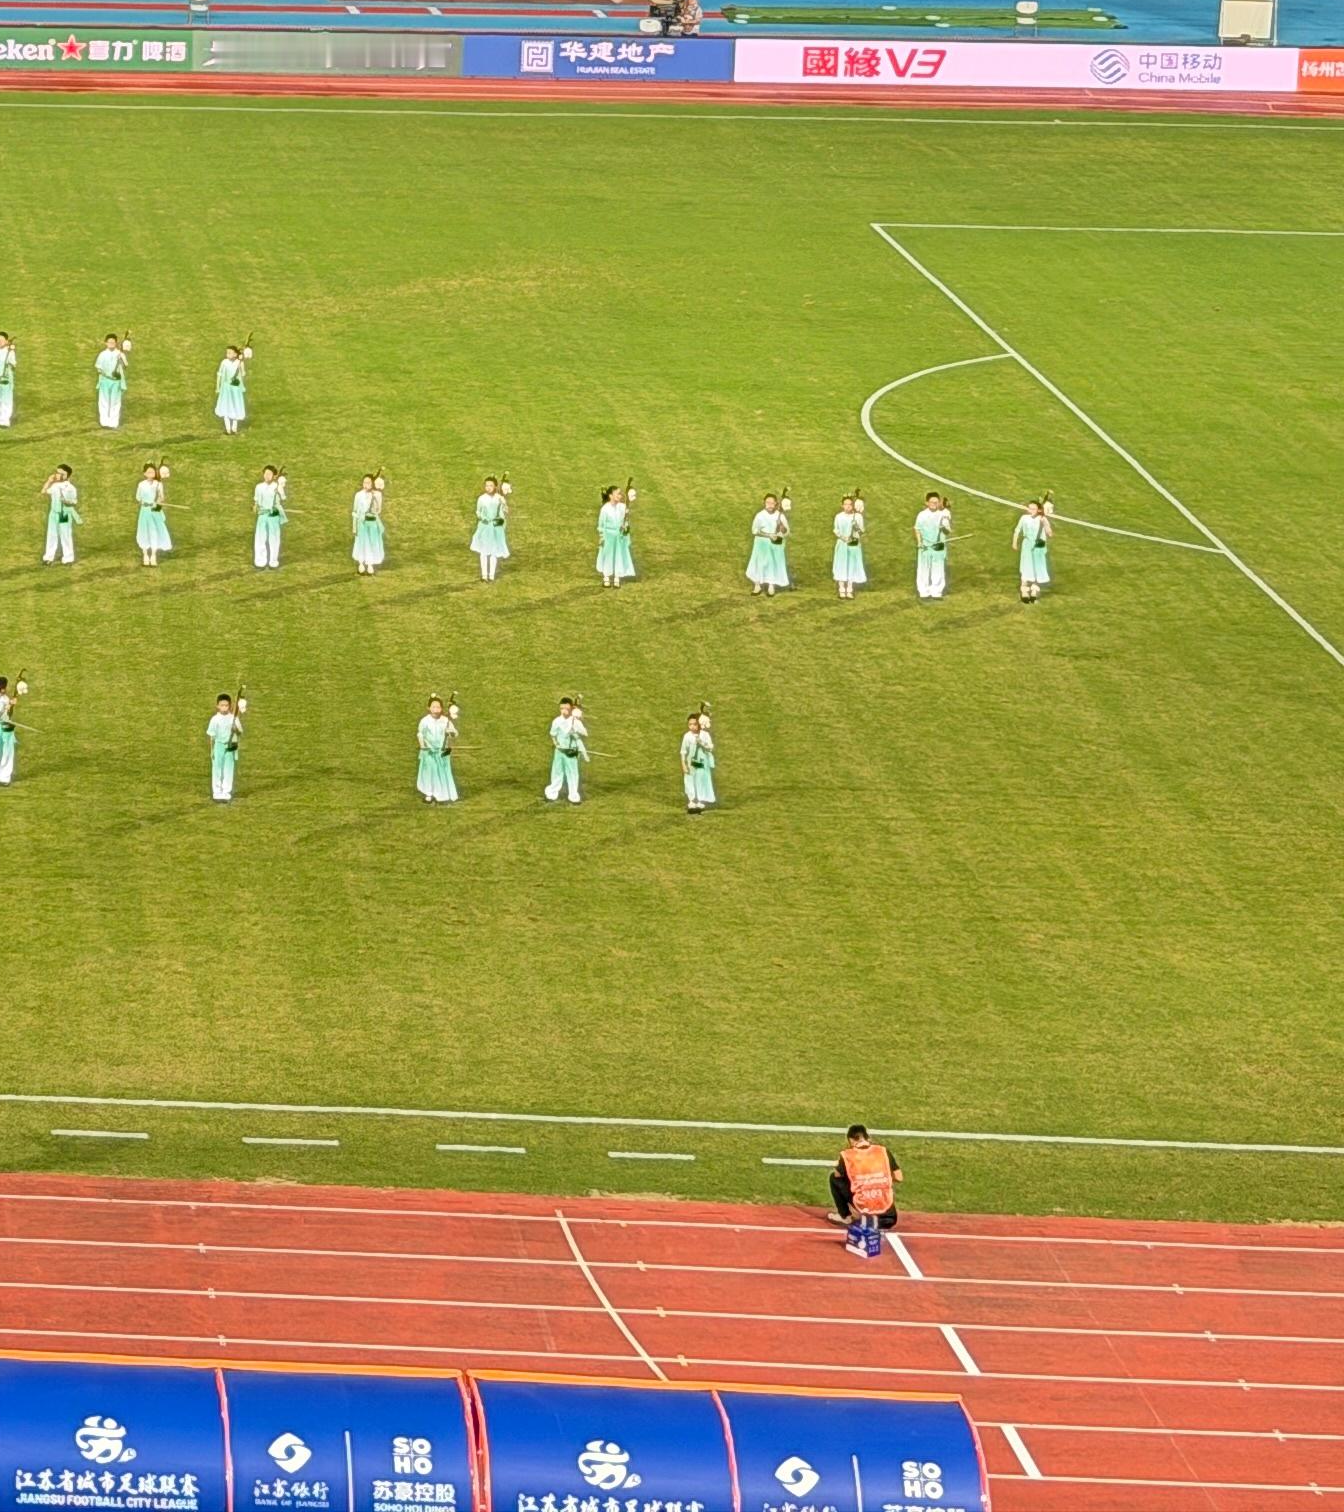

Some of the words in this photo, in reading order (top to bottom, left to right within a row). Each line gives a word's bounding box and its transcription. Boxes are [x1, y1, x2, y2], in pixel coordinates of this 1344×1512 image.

[559, 41, 675, 63] 华建地产
[1139, 53, 1222, 70] 中国移动
[1138, 72, 1175, 84] China
[1179, 72, 1221, 85] Mobile
[16, 1469, 199, 1497] 江苏省城市足球联赛
[254, 1478, 329, 1500] 江苏银行
[372, 1480, 456, 1504] 苏豪控股
[16, 1493, 65, 1505] JIANGSU
[67, 1494, 125, 1508] FOOTBALL
[126, 1496, 152, 1509] CITY
[153, 1497, 199, 1510] LEAGUE
